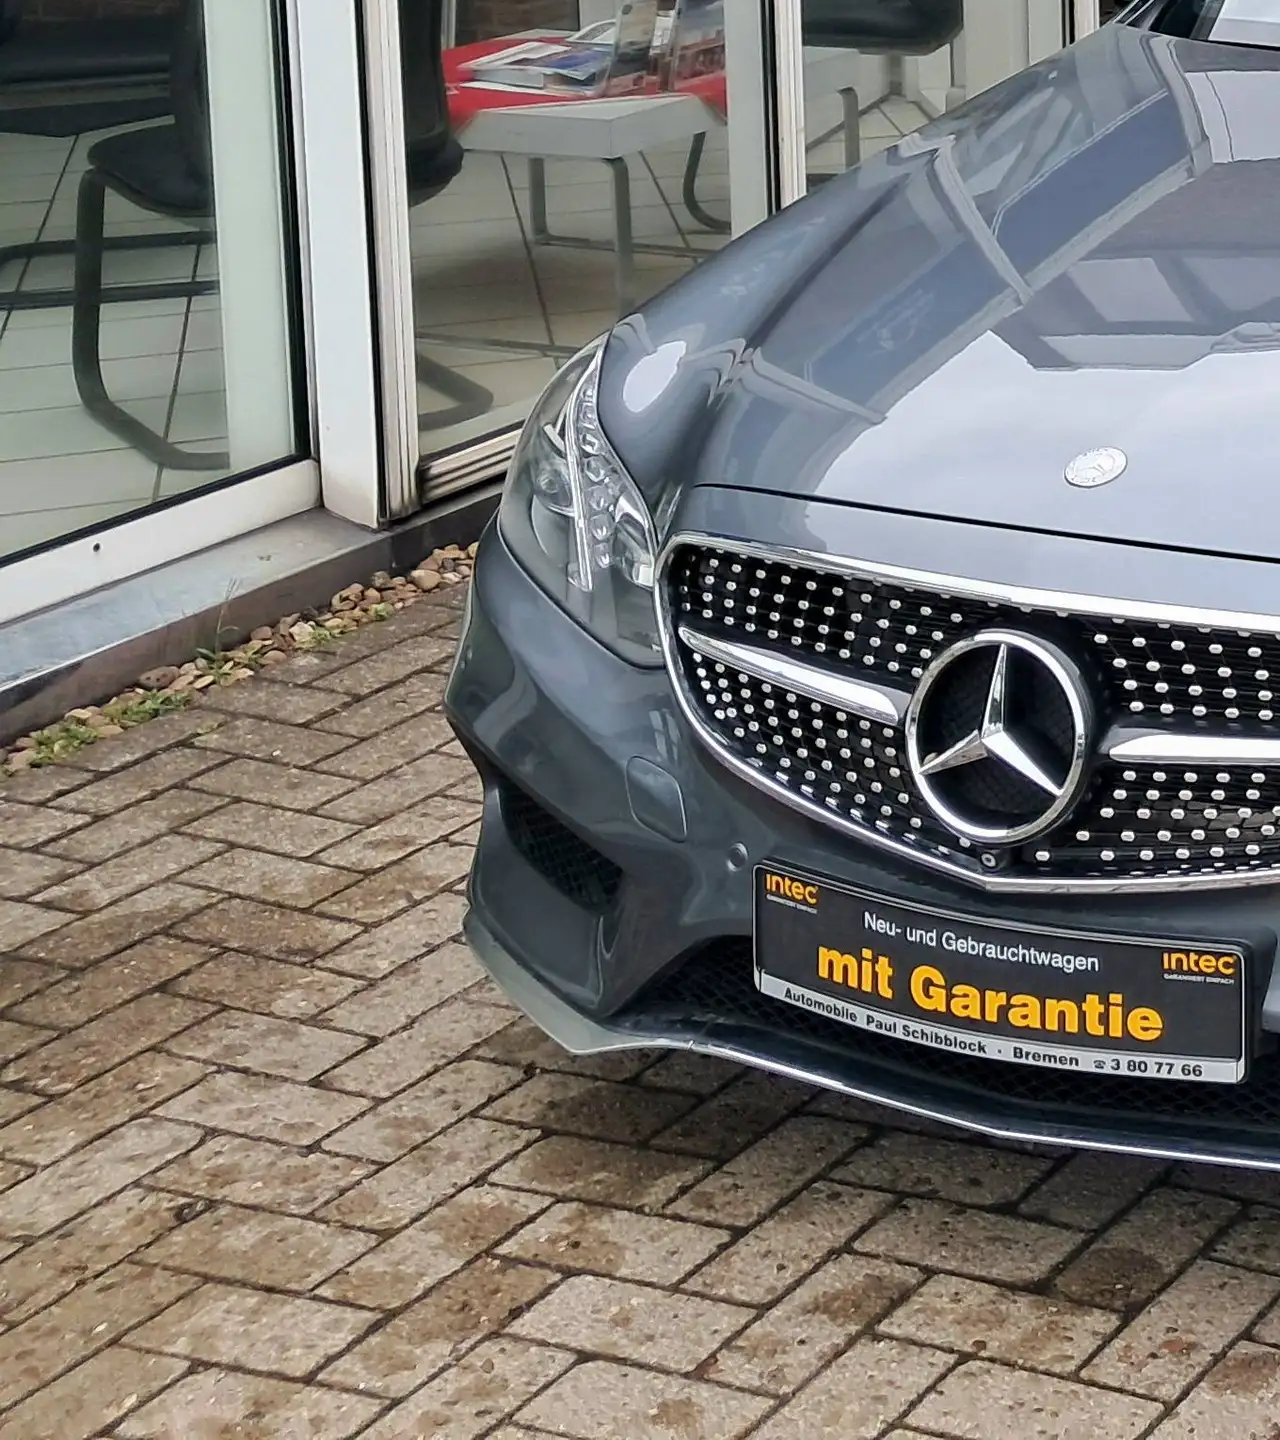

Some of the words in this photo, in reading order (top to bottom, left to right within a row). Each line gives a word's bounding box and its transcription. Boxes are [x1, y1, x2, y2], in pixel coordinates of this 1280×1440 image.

[766, 873, 818, 905] intec
[863, 911, 902, 937] Neu-
[906, 926, 937, 947] und
[941, 930, 1100, 974] Gebrauchtwagen
[1162, 951, 1236, 975] intec
[817, 943, 894, 1000] mit
[909, 965, 1165, 1043] Garantie
[784, 986, 858, 1023] Automobile
[865, 1014, 897, 1034] Paul
[901, 1024, 987, 1055] Schibblock
[1012, 1046, 1080, 1067] Bremen
[1110, 1058, 1121, 1071] 3
[1126, 1059, 1148, 1073] 80
[1154, 1061, 1175, 1076] 77
[1180, 1063, 1203, 1077] 66
